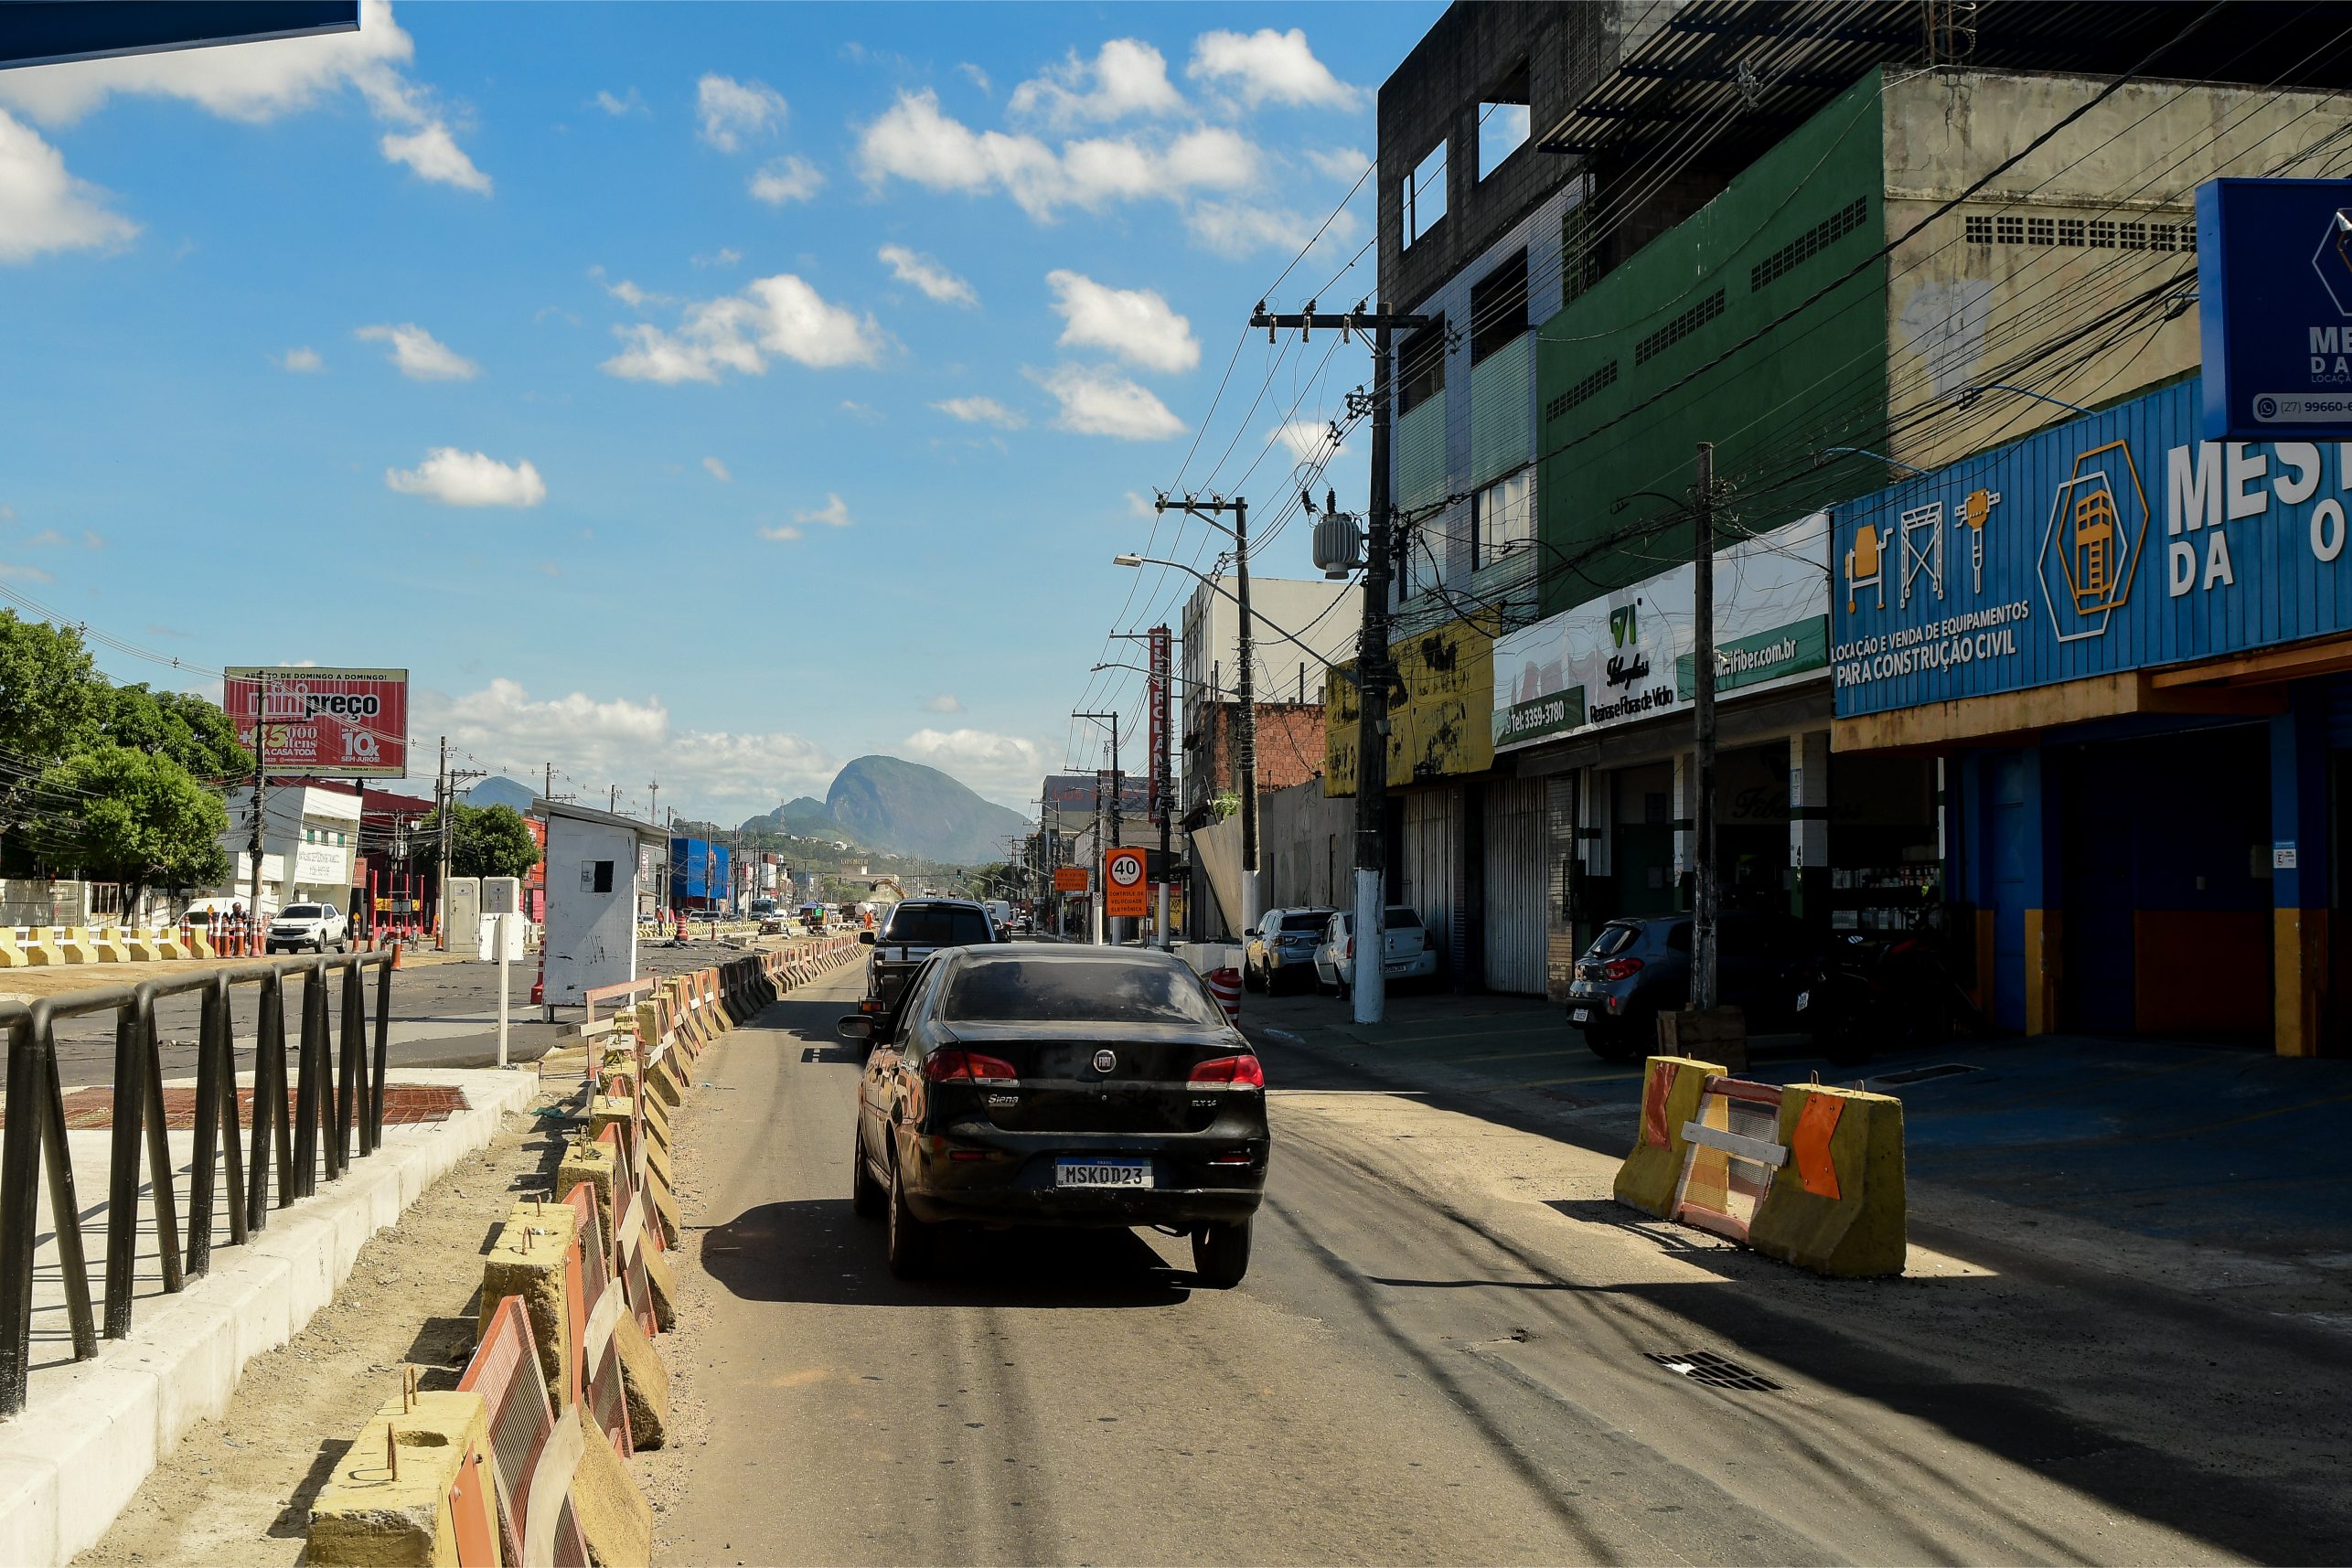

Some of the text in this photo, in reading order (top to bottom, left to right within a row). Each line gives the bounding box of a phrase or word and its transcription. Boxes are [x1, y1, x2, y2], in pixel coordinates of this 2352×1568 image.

[2311, 356, 2349, 374] DA
[2281, 400, 2302, 414] (27)
[2168, 440, 2352, 536] MES
[2169, 530, 2234, 597] DA
[1831, 600, 2029, 663] LOCAÇÃO E VENDA DE EQUIPAMENTOS
[1836, 628, 2016, 688] PARA CONSTRUÇÃO CIVIL
[1511, 699, 1565, 733] Tel: 3359-3780
[271, 748, 293, 756] CASA
[295, 748, 317, 756] TODA
[1114, 860, 1137, 875] 40
[1098, 1056, 1111, 1067] FIAT
[988, 1093, 1019, 1104] Siena
